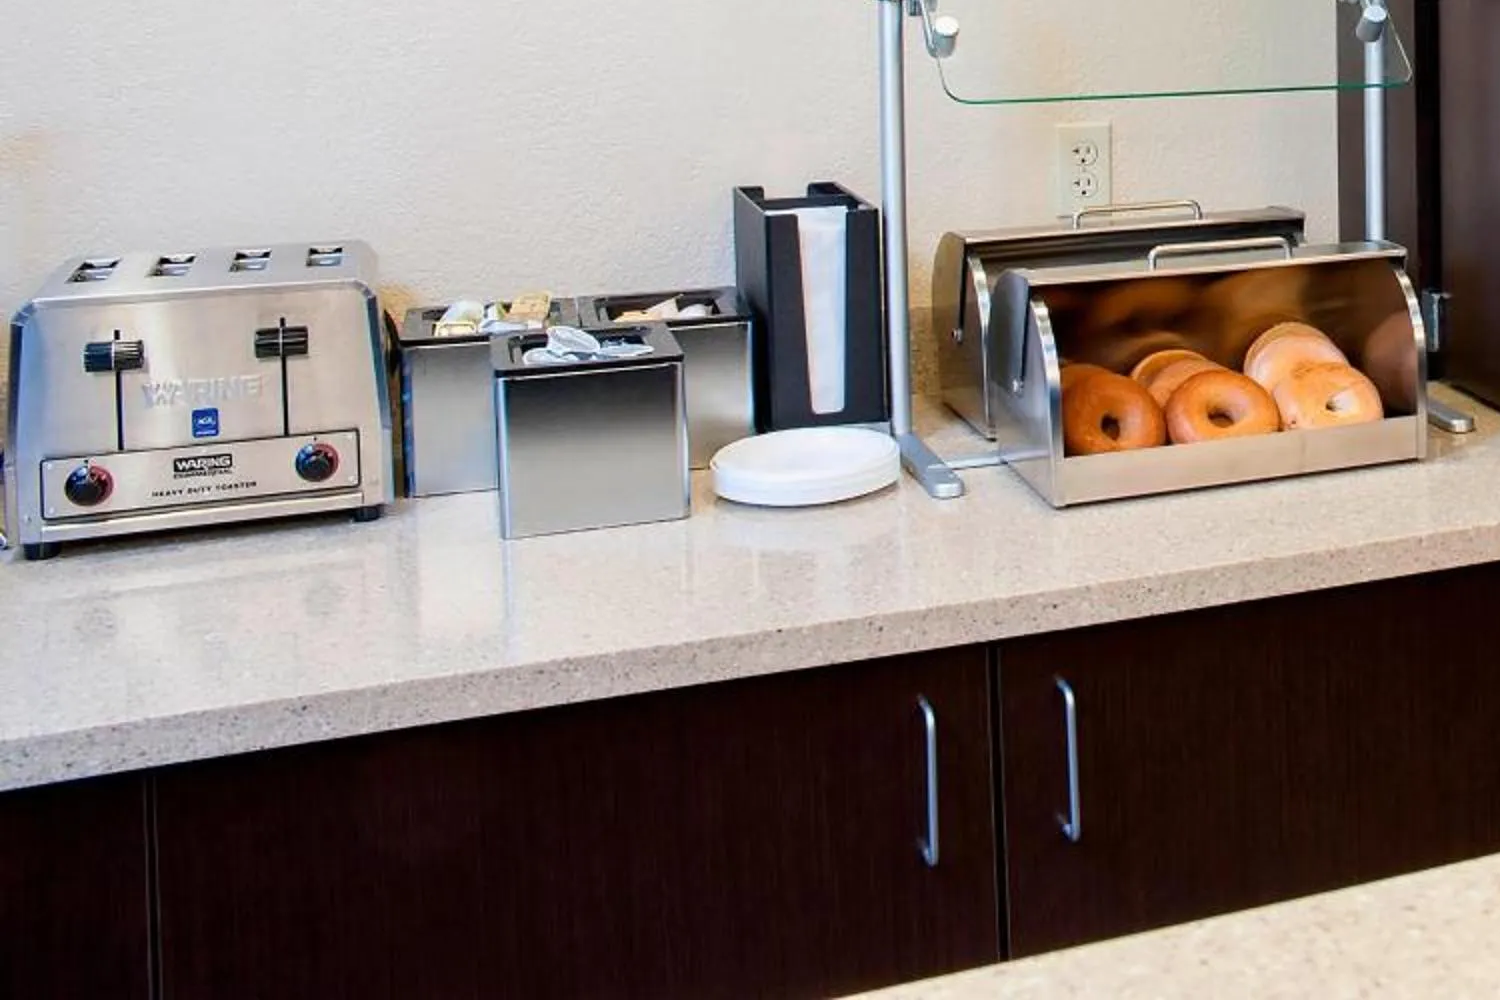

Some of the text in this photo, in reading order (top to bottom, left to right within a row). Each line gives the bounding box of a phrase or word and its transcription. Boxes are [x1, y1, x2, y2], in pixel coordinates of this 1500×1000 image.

[176, 456, 231, 471] WARING
[152, 488, 183, 497] HEAVY
[187, 485, 212, 494] DUTY
